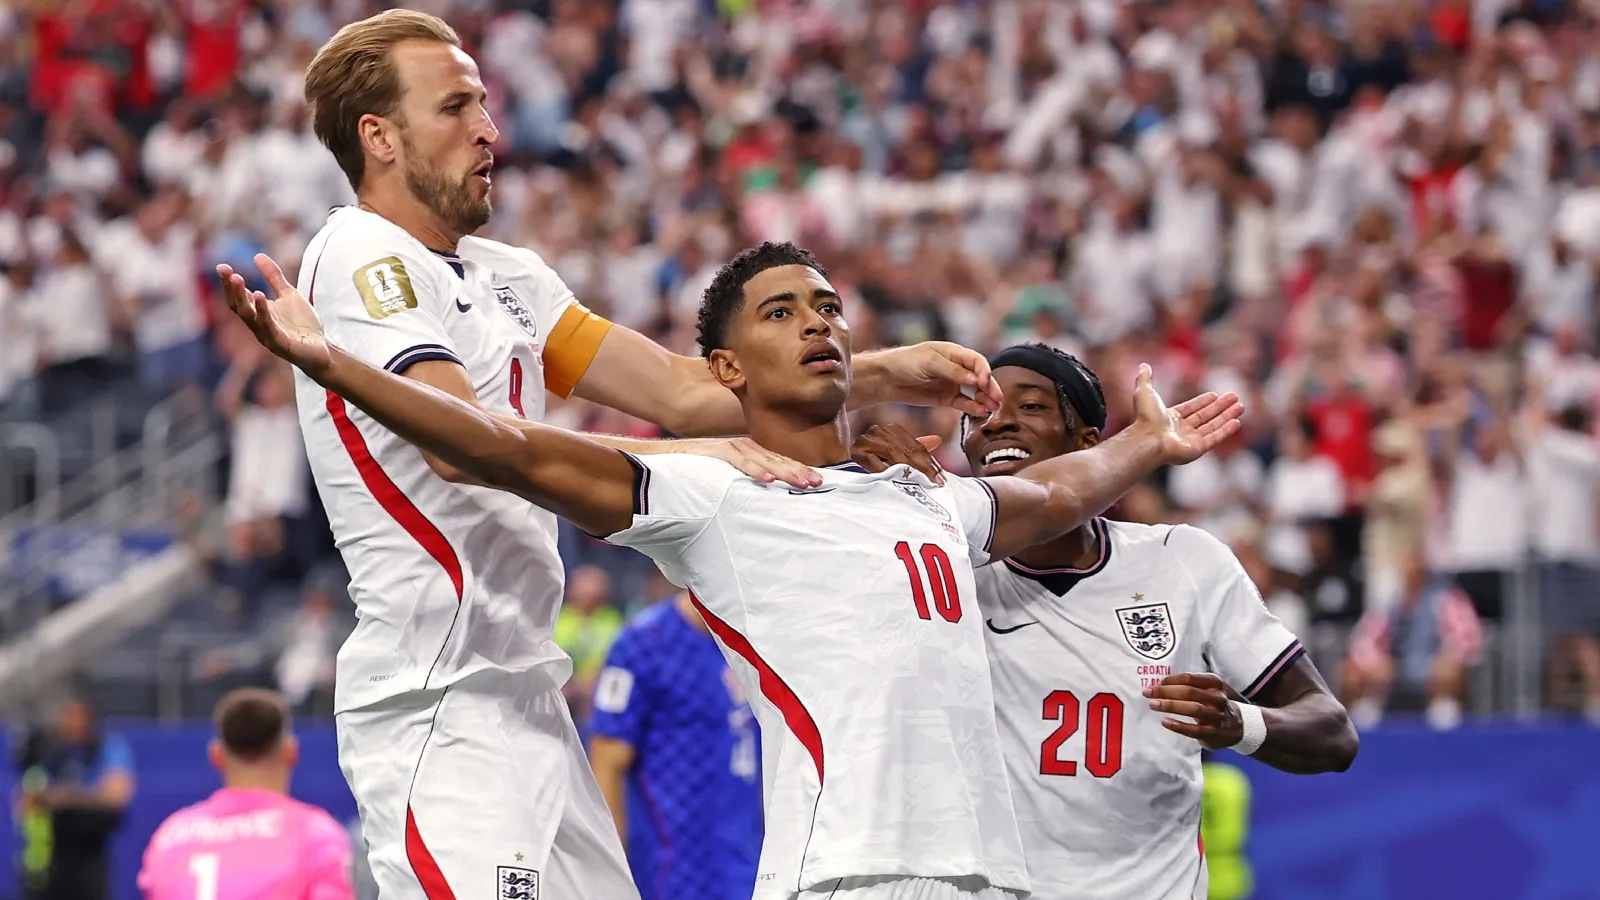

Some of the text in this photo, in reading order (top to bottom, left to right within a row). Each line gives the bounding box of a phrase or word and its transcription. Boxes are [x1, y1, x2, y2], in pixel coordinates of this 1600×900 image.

[508, 357, 526, 420] 9
[894, 541, 963, 624] 10
[1137, 665, 1172, 676] CROATIA
[1040, 690, 1124, 778] 20
[188, 853, 219, 900] 1
